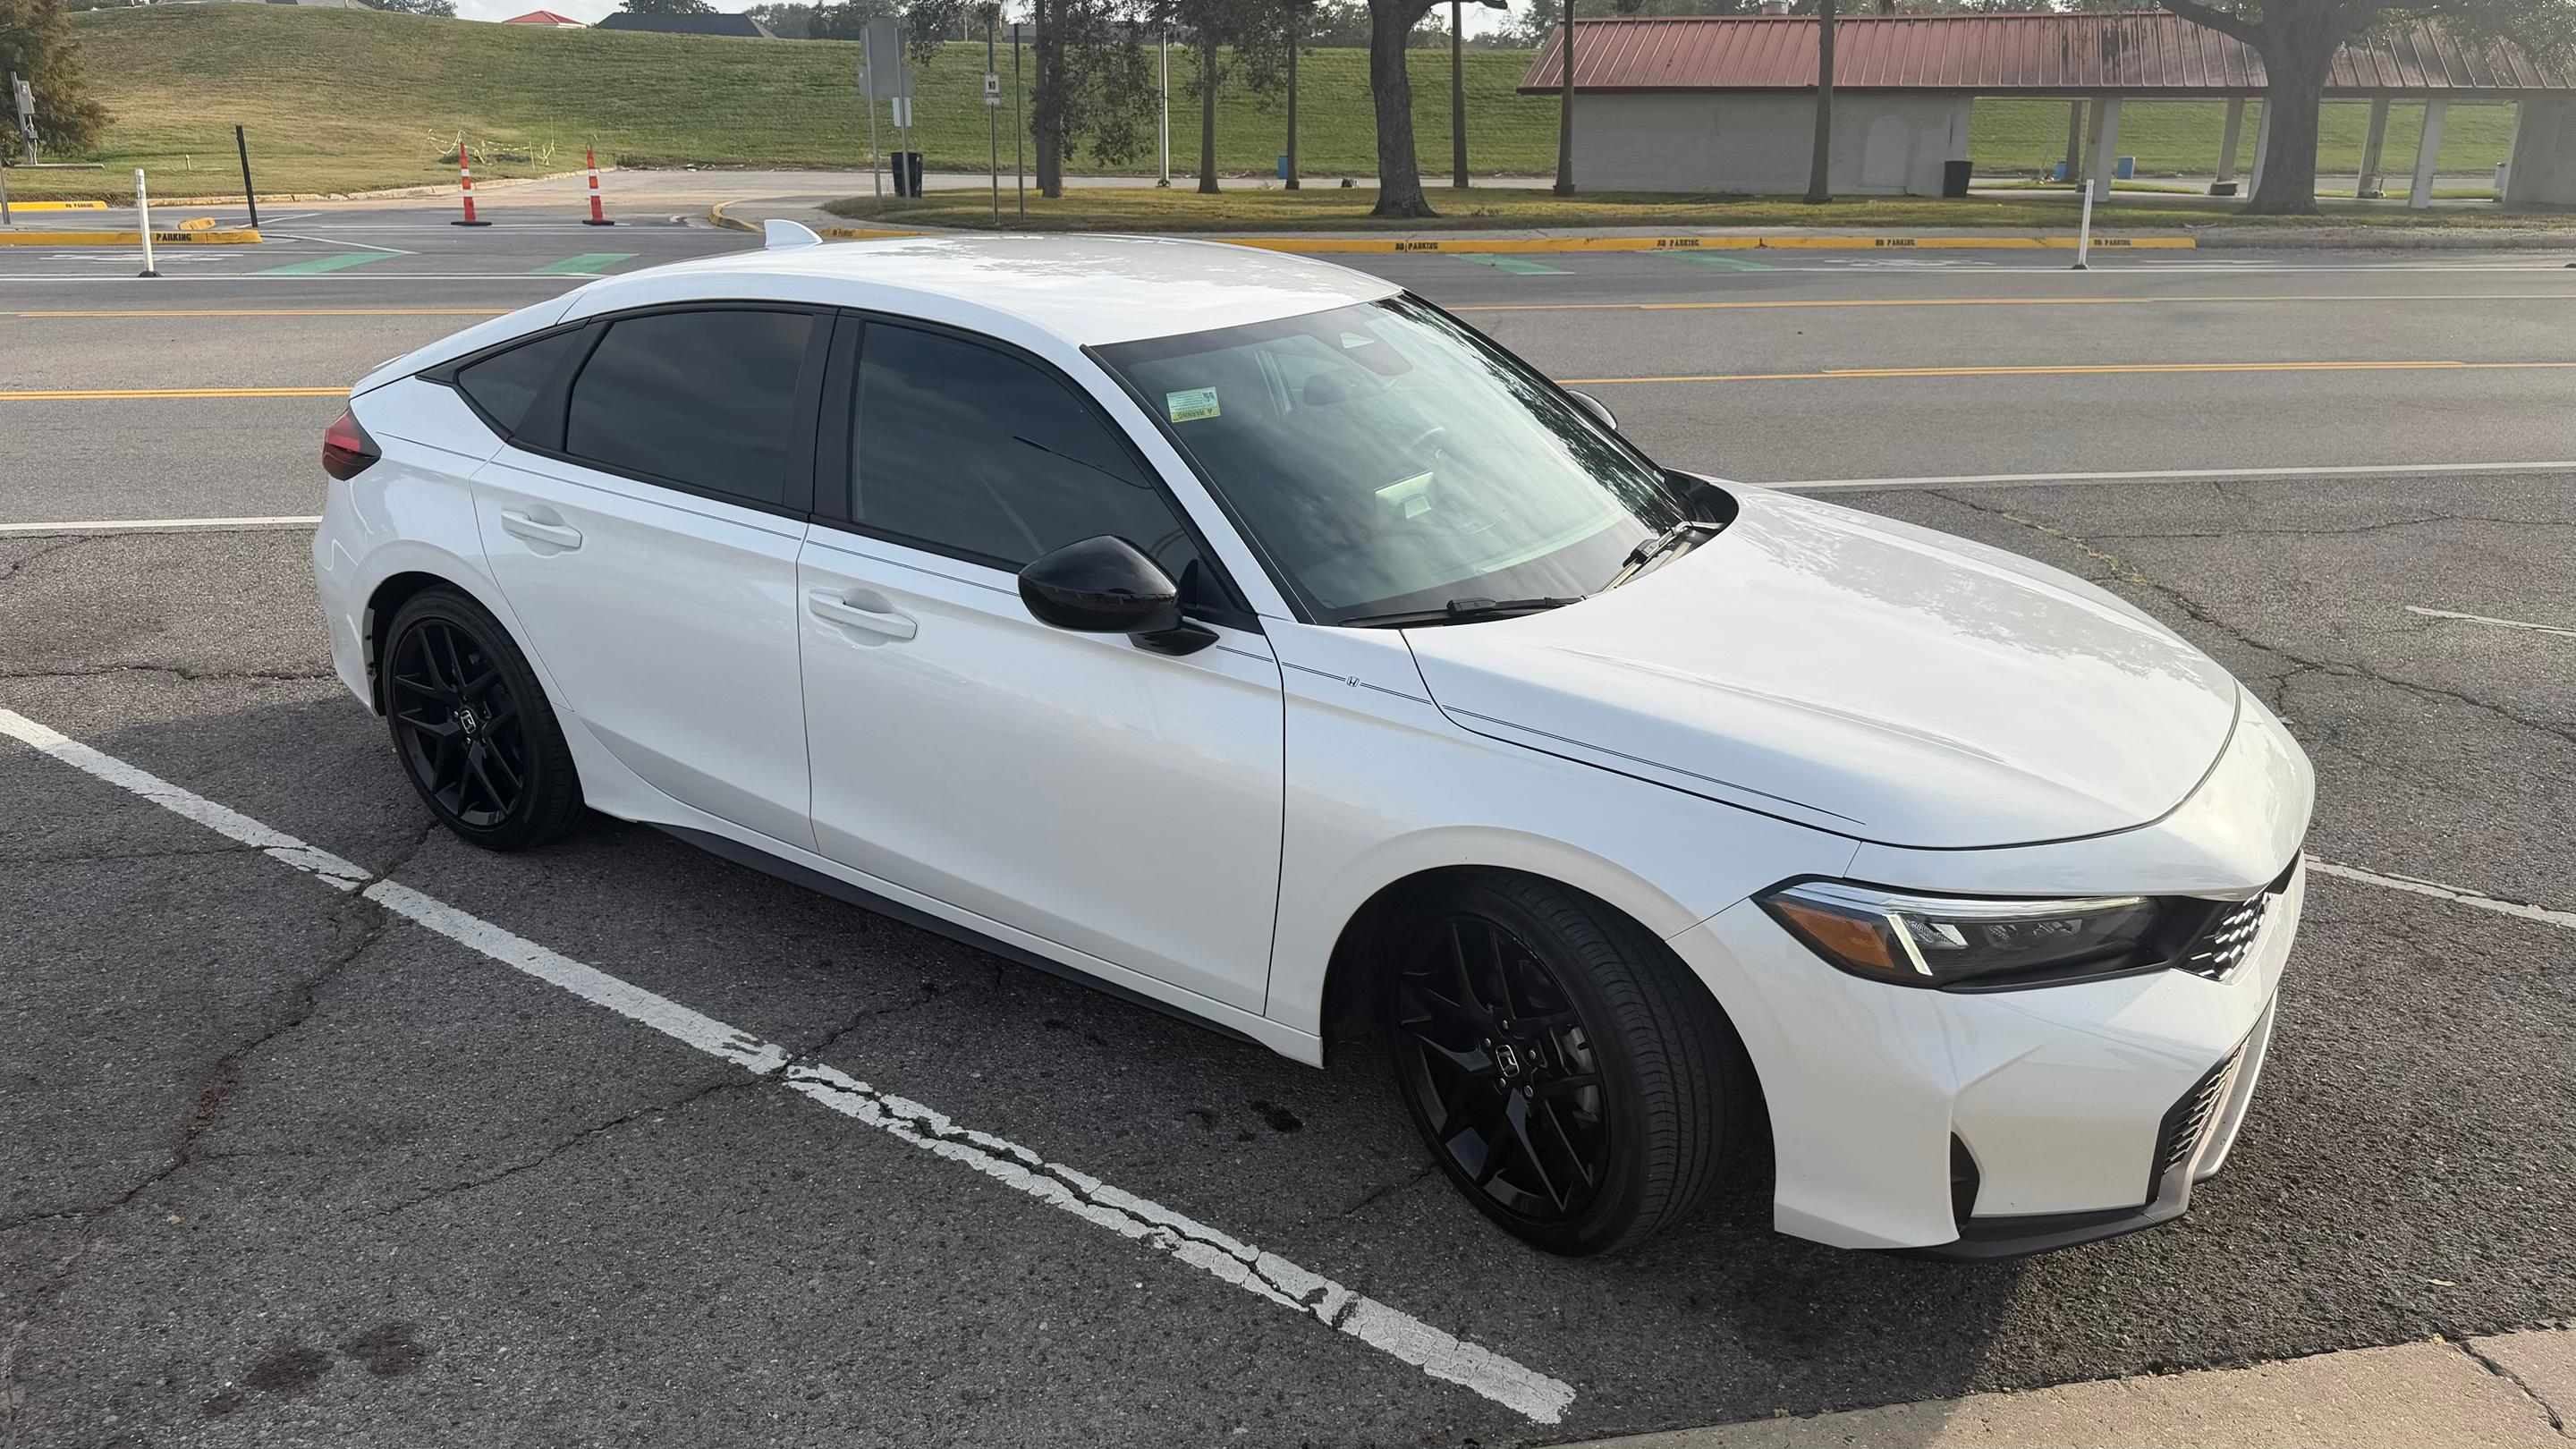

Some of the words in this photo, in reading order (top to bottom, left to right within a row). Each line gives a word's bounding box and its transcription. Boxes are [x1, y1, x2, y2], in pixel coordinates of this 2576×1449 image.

[156, 233, 192, 242] PARKING
[1395, 242, 1405, 250] NO
[1408, 242, 1438, 250] PARKING
[1657, 239, 1666, 247] NO
[1669, 239, 1699, 247] PARKING
[1887, 238, 1916, 246] PARKING
